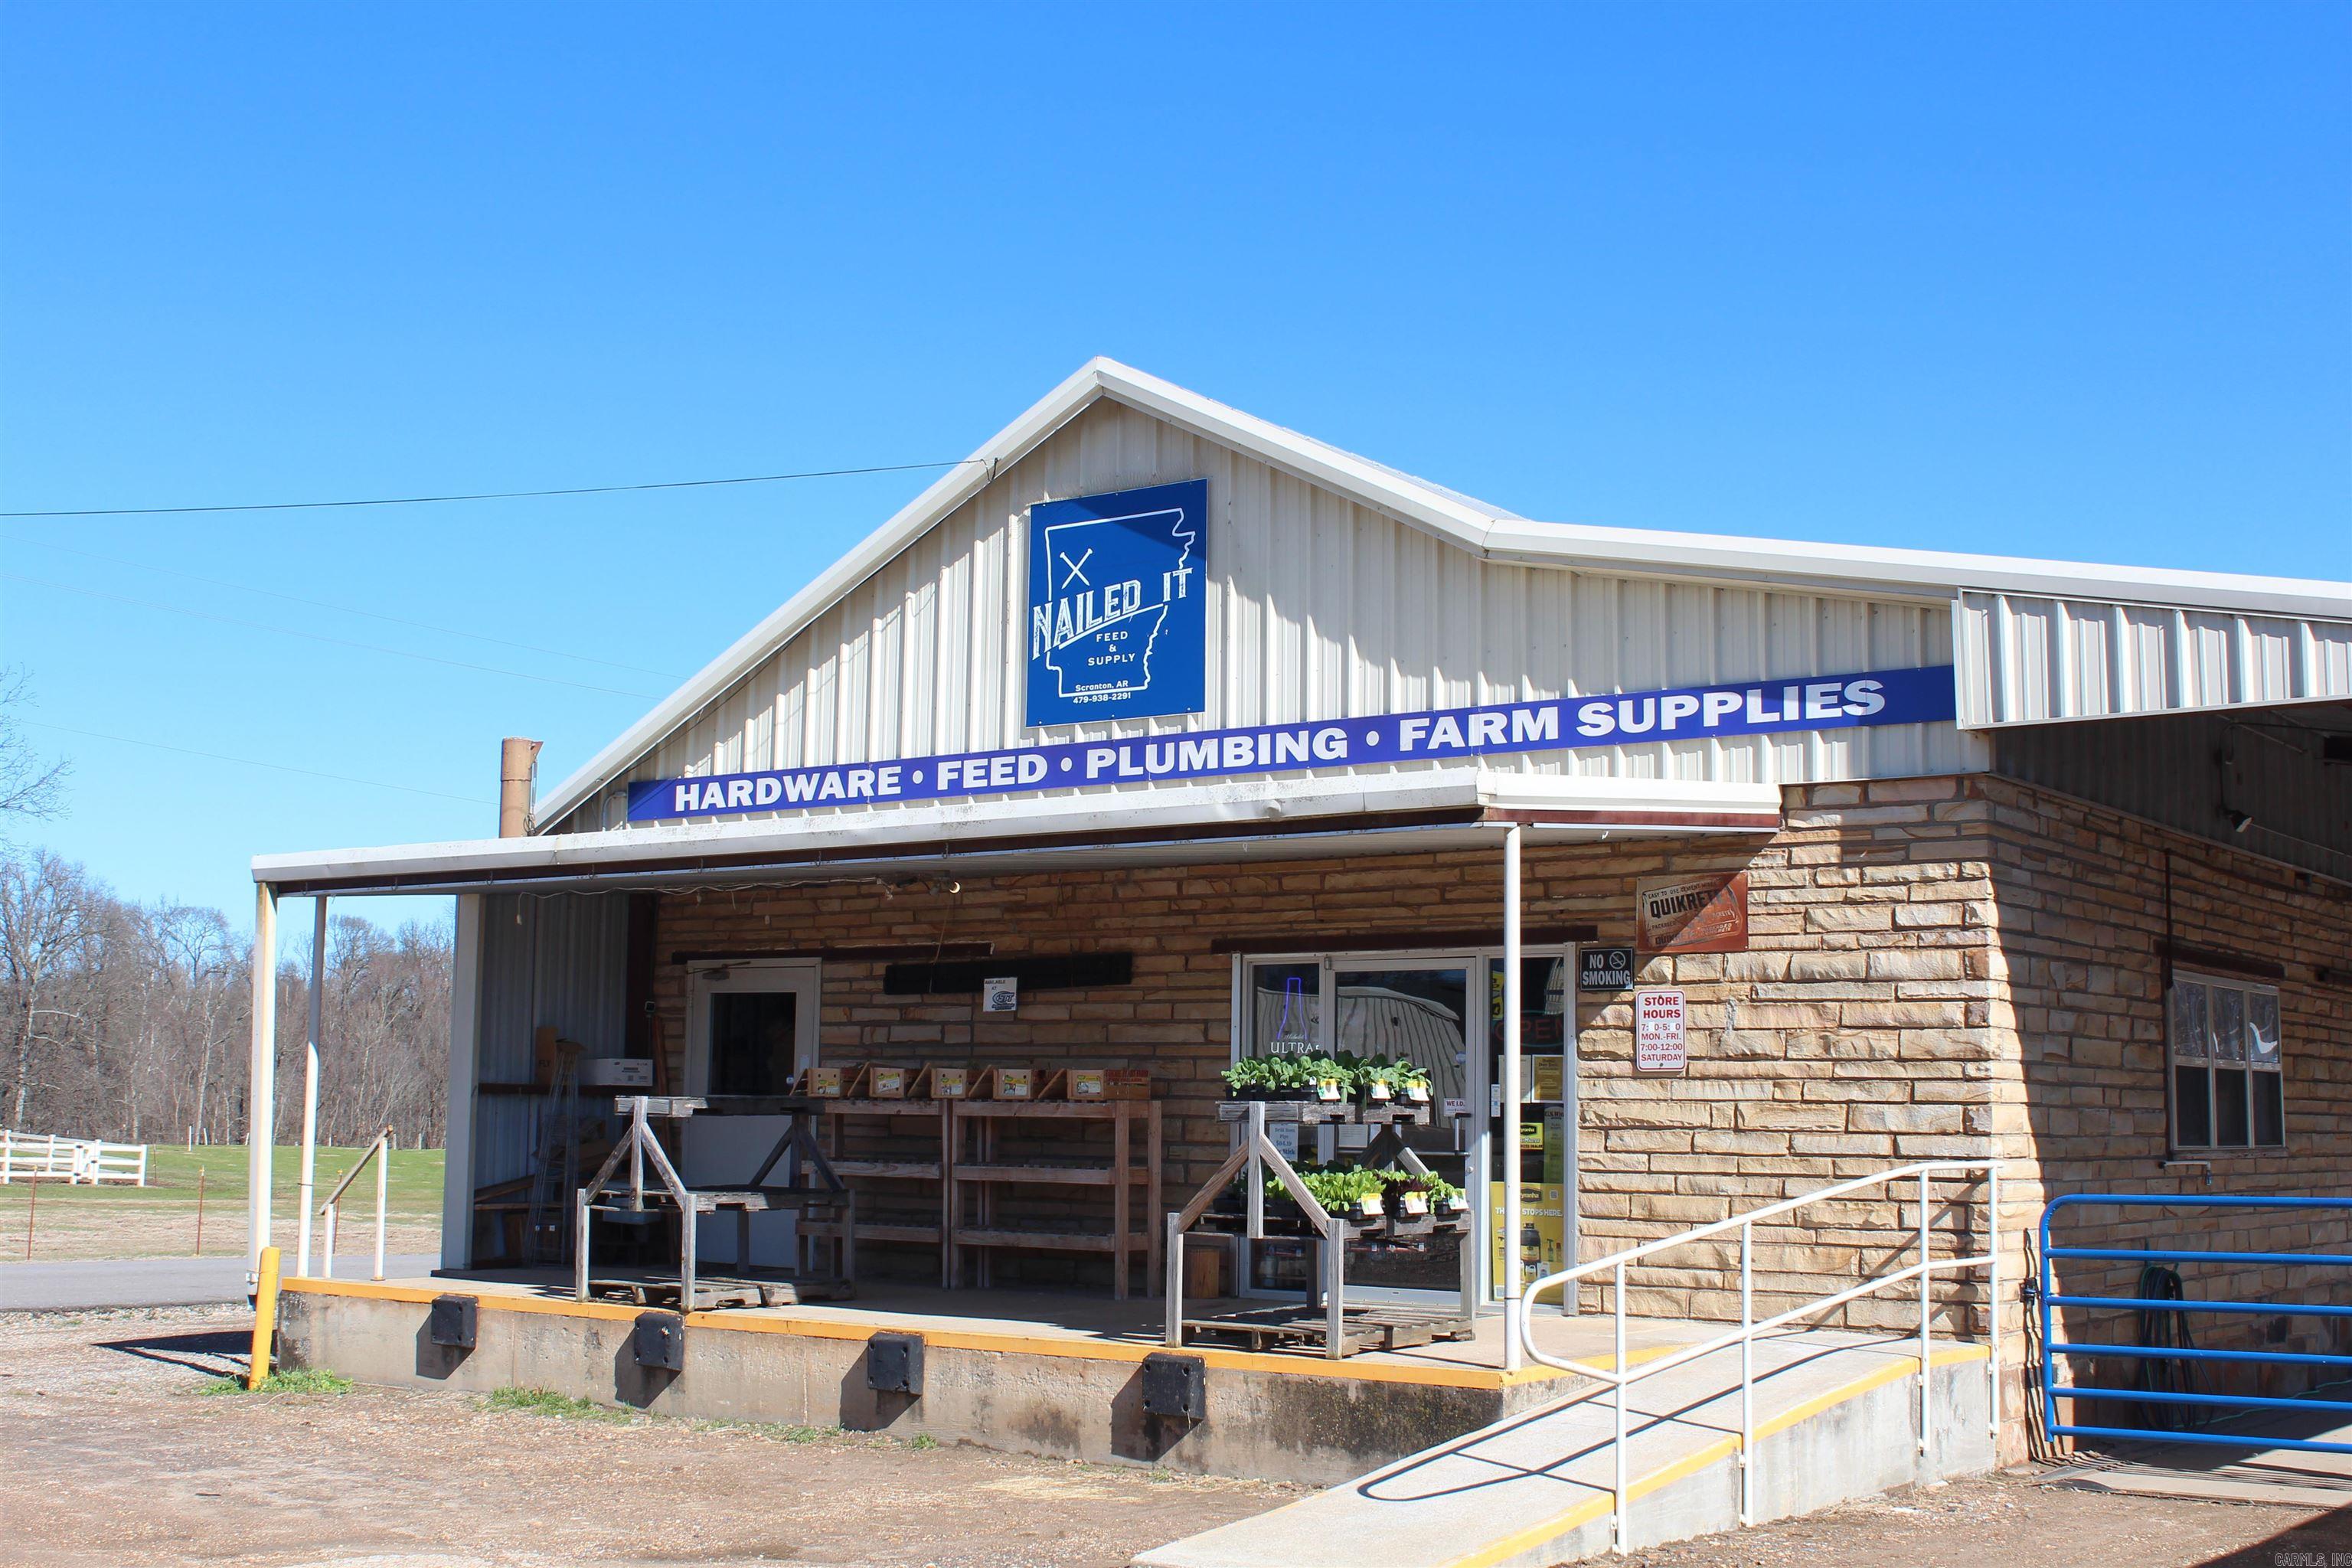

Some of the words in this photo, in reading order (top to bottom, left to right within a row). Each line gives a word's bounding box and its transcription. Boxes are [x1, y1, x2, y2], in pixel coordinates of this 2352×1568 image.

[1033, 580, 1141, 660] NAILED
[1162, 568, 1193, 602] IT
[1096, 631, 1129, 643] FEED
[1109, 644, 1116, 652] &
[1088, 653, 1135, 666] SUPPLY
[1073, 692, 1131, 704] 479-938-2291
[675, 768, 902, 812] HARDWARE
[936, 753, 1047, 791] FEED
[1086, 728, 1348, 779] PLUMBING
[1399, 706, 1560, 752] FARM
[1576, 678, 1886, 737] SUPPLIES
[1589, 954, 1604, 969] NO
[1582, 969, 1632, 986] SMOKING
[1645, 997, 1679, 1006] STORE
[1643, 1009, 1681, 1018] HOURS
[1642, 1023, 1681, 1031] 7:0-5:0
[1271, 1041, 1313, 1054] ULTRA
